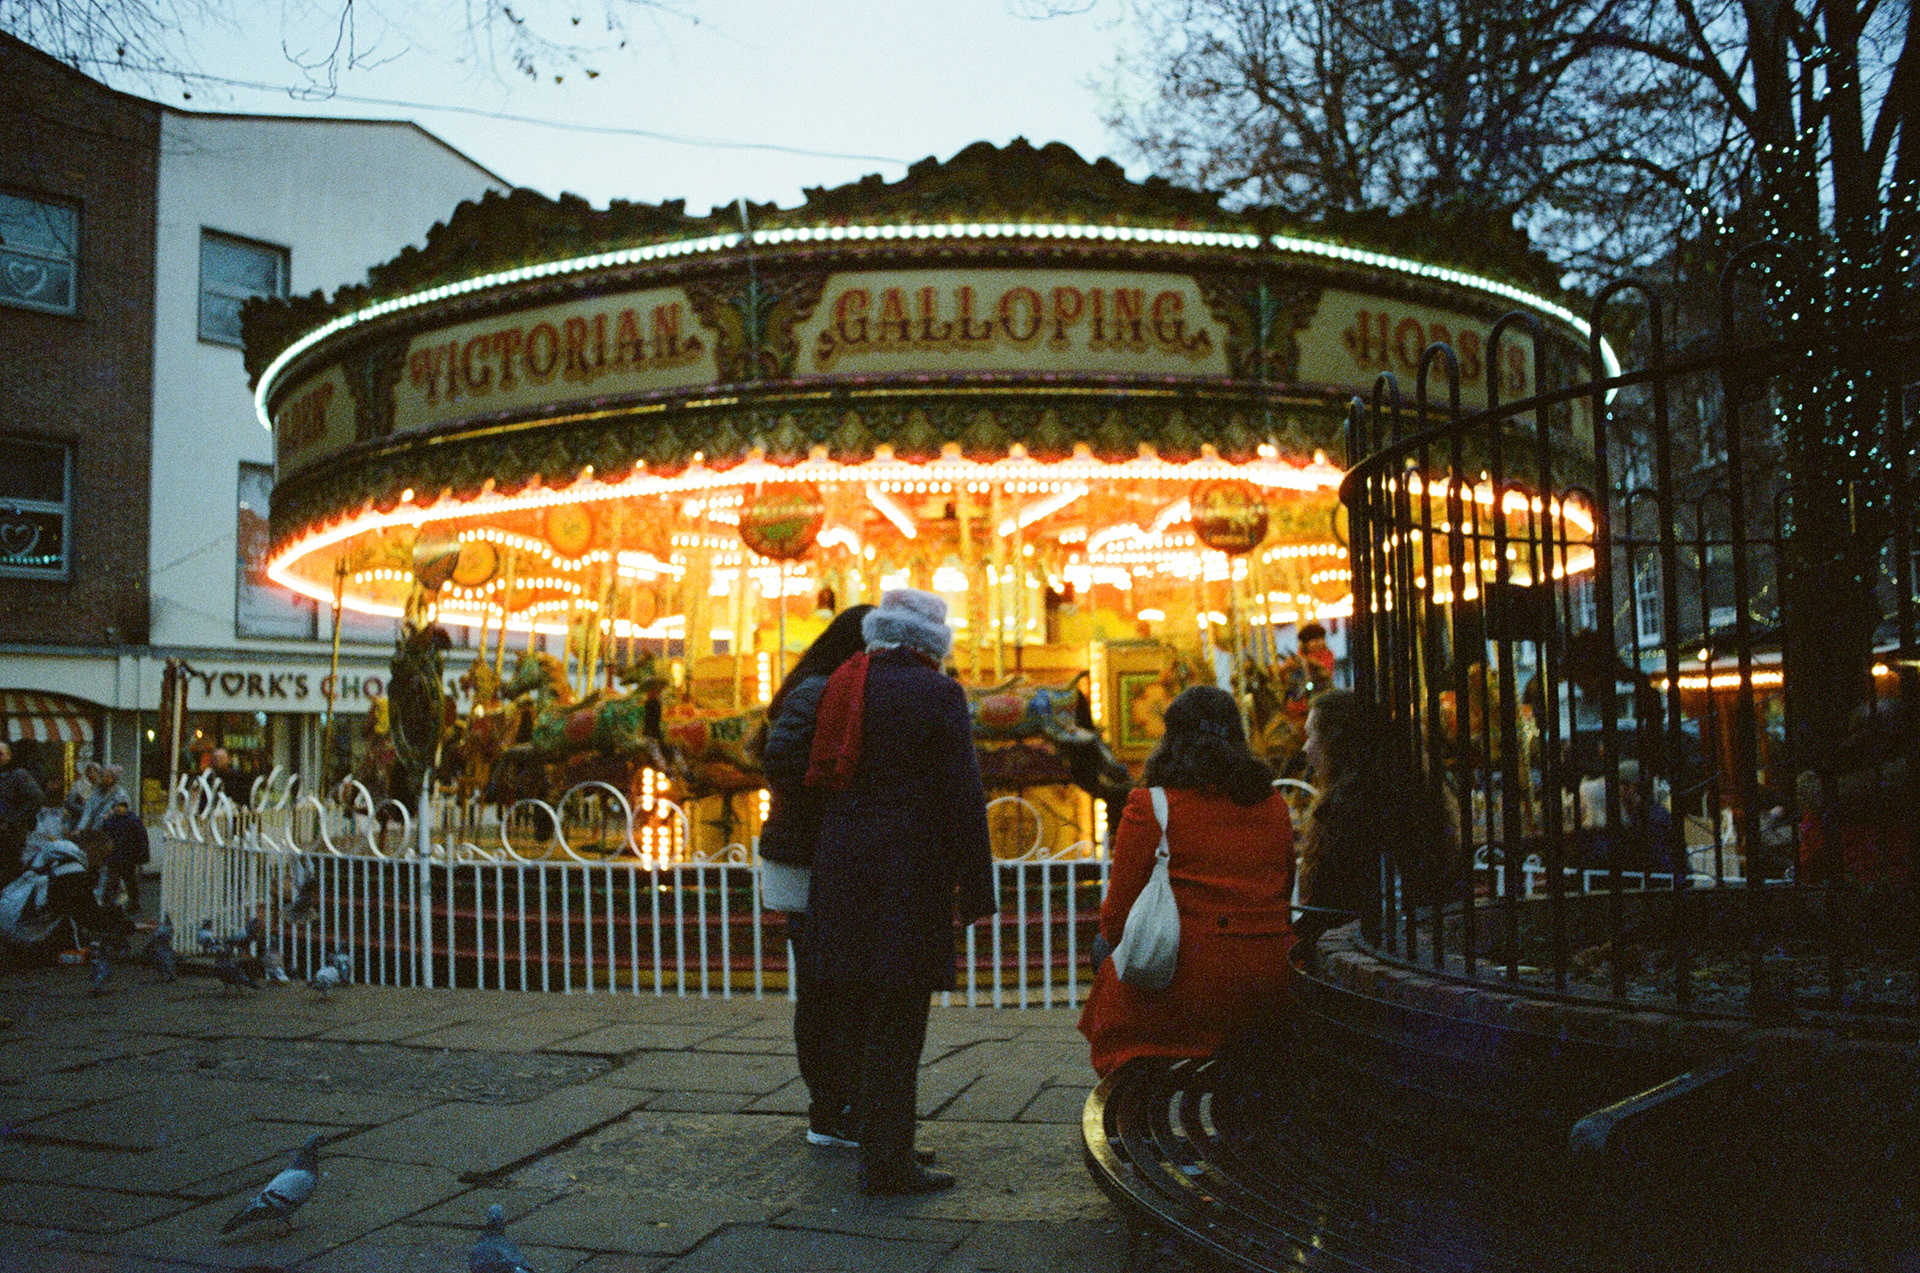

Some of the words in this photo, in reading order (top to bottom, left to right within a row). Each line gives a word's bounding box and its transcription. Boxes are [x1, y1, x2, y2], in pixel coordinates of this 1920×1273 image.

[409, 302, 703, 402] VICTORIAN
[814, 285, 1212, 356] GALLOPING
[1344, 309, 1527, 393] HORSS
[200, 671, 308, 698] YORK'S
